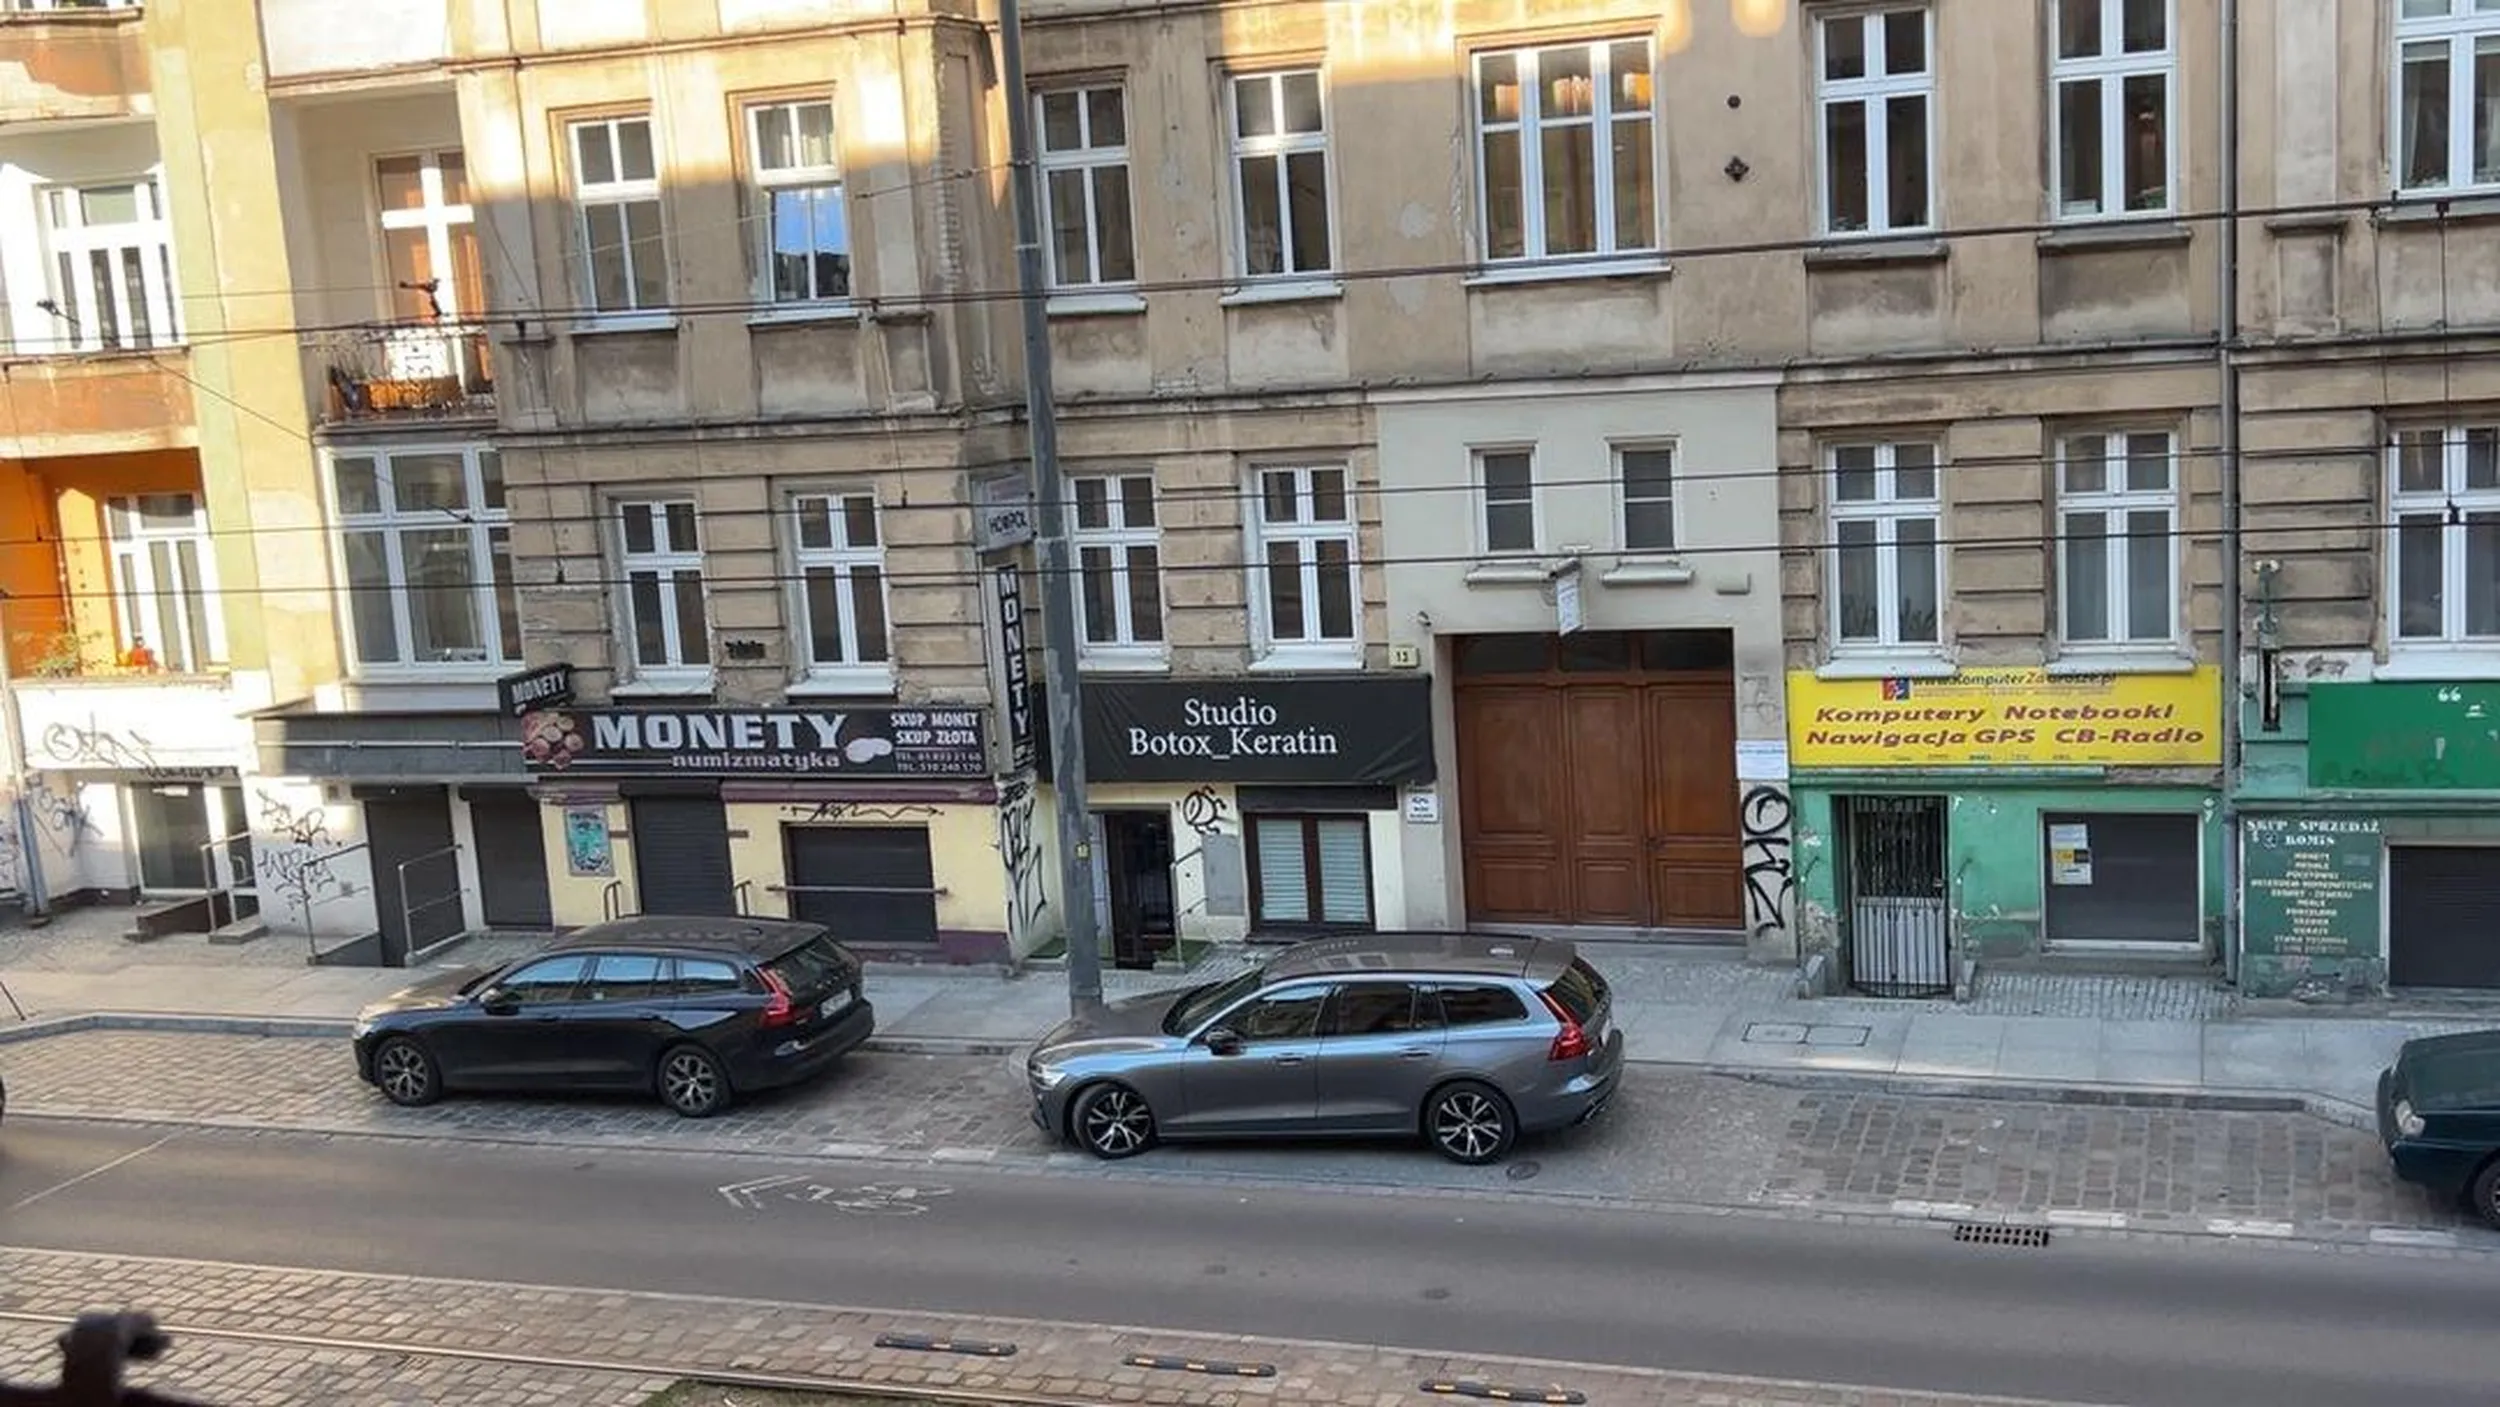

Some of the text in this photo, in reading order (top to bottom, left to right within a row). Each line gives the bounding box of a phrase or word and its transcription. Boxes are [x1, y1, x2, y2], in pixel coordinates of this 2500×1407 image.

[1000, 572, 1028, 736] MONETY
[510, 670, 567, 704] MONETY
[890, 711, 978, 728] SKUP MONET
[1184, 697, 1277, 726] Studio
[1816, 704, 2174, 724] Komputery Notebooki
[592, 712, 847, 750] MONETY
[896, 730, 977, 745] SKUP ZŁOTA
[1129, 726, 1338, 759] Botox_Keratin
[1806, 728, 2204, 747] Nawigacja GPS CB-Radio
[672, 751, 841, 771] numizmatyka
